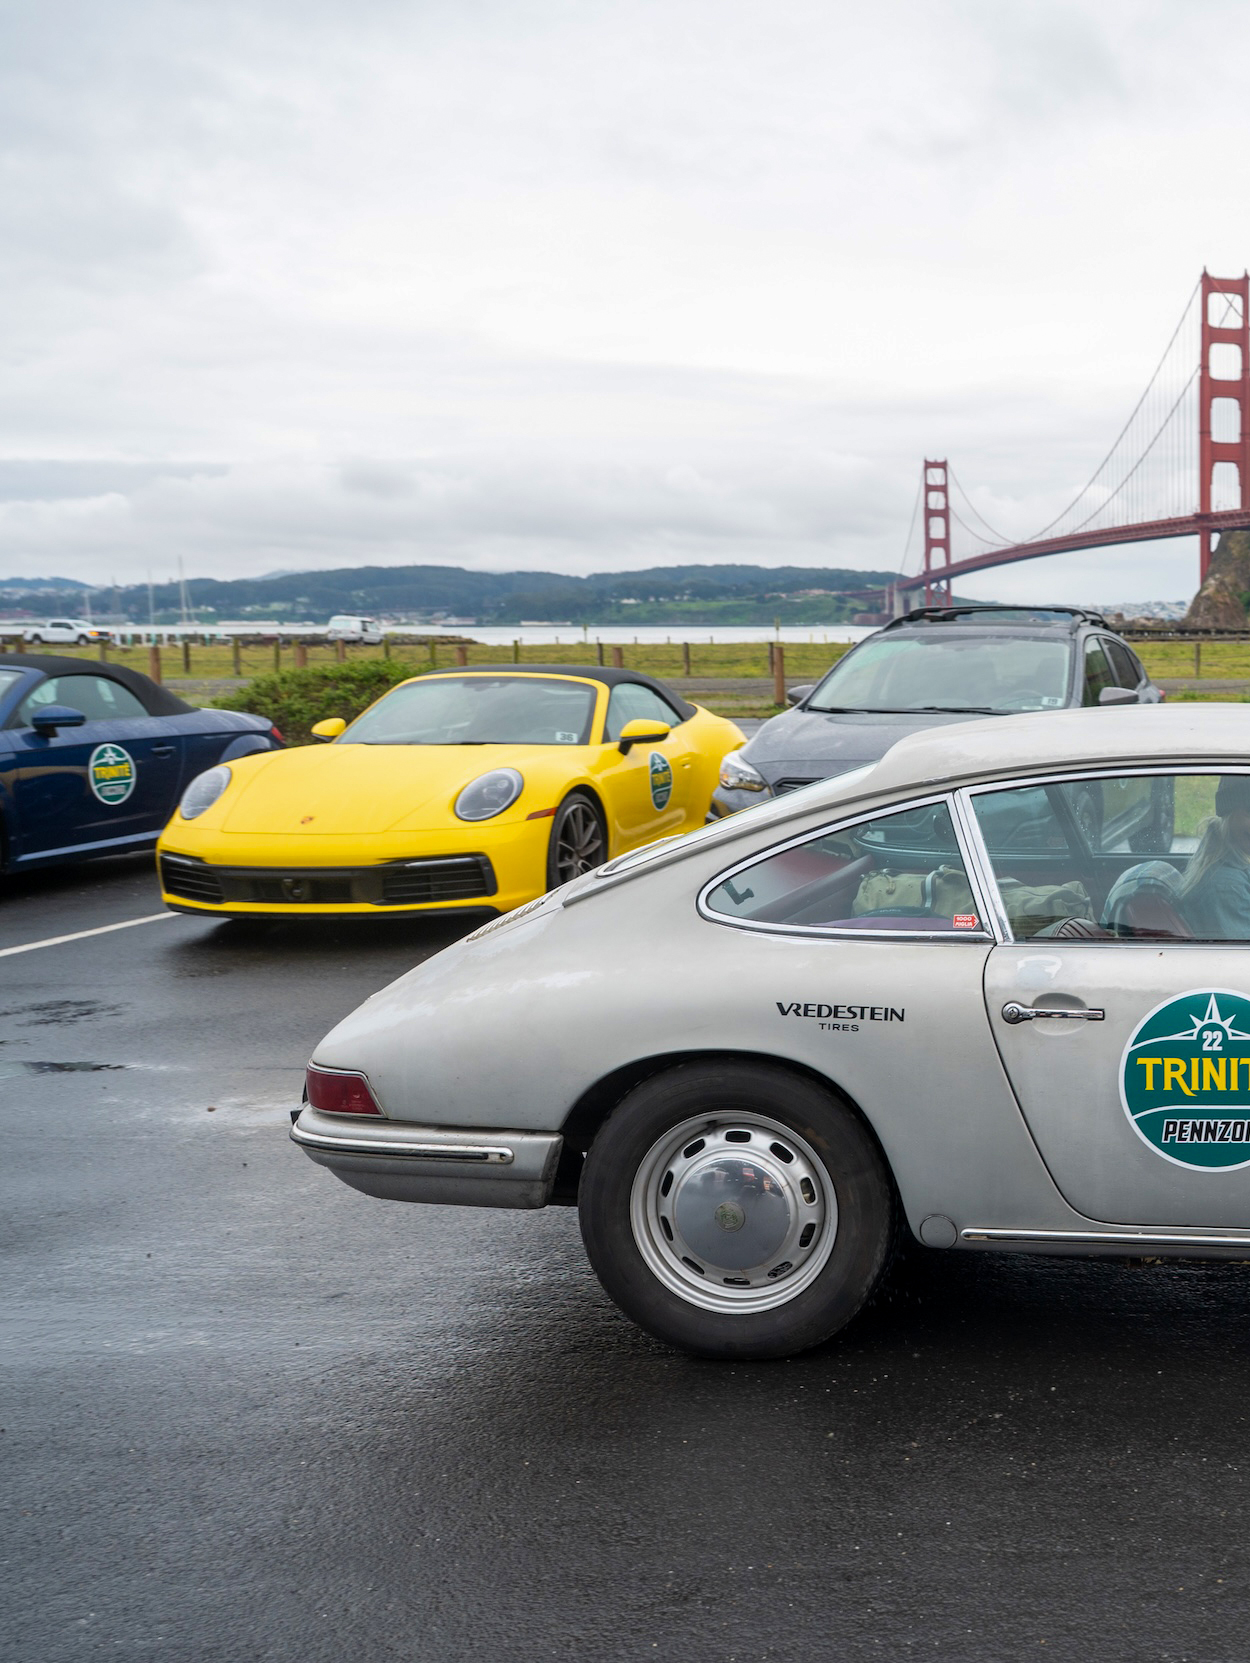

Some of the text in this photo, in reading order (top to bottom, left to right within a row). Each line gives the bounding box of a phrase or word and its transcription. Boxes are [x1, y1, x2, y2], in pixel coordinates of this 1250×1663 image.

[776, 1002, 905, 1022] VREDESTEIN
[818, 1022, 860, 1032] TIRES
[1202, 1030, 1223, 1051] 22
